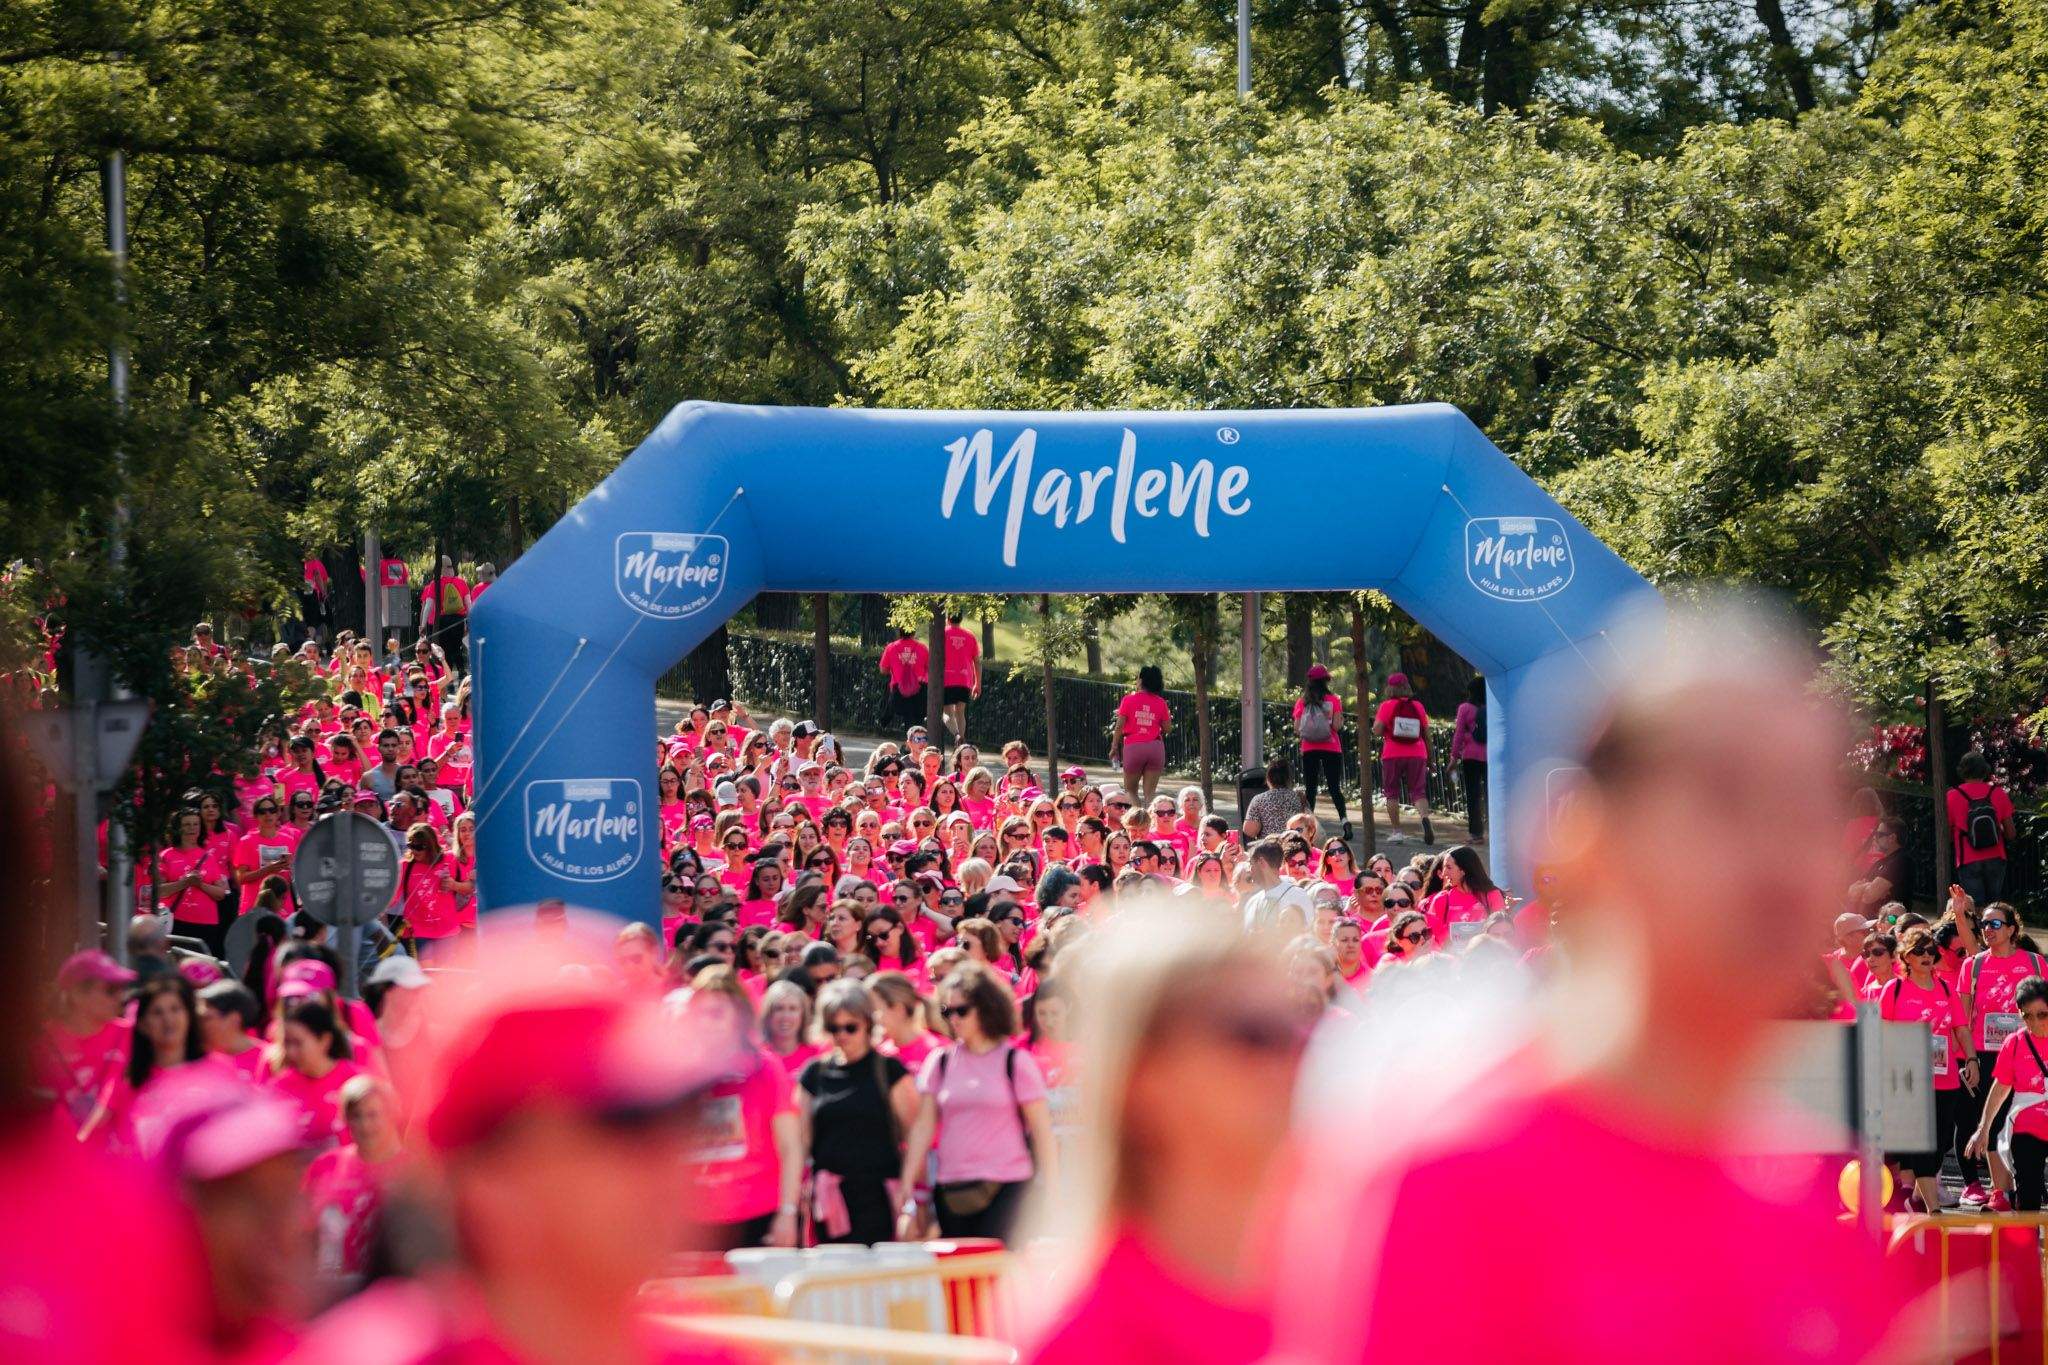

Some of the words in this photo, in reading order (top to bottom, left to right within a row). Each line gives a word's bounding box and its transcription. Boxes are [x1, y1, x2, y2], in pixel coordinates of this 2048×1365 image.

[941, 427, 1251, 567] Marlene
[624, 551, 719, 595] Marlene
[1474, 535, 1566, 579] Marlene
[650, 603, 662, 612] DE
[664, 605, 680, 613] LOS
[682, 596, 707, 611] ALPES
[1480, 577, 1499, 592] HIJA
[1502, 588, 1514, 596] DE
[1517, 587, 1535, 596] LOS
[1537, 576, 1563, 593] ALPES
[535, 802, 637, 854] Marlene
[542, 853, 564, 870] HIJA
[566, 864, 581, 874] DE
[584, 866, 604, 876] LOS
[606, 853, 632, 873] ALPES
